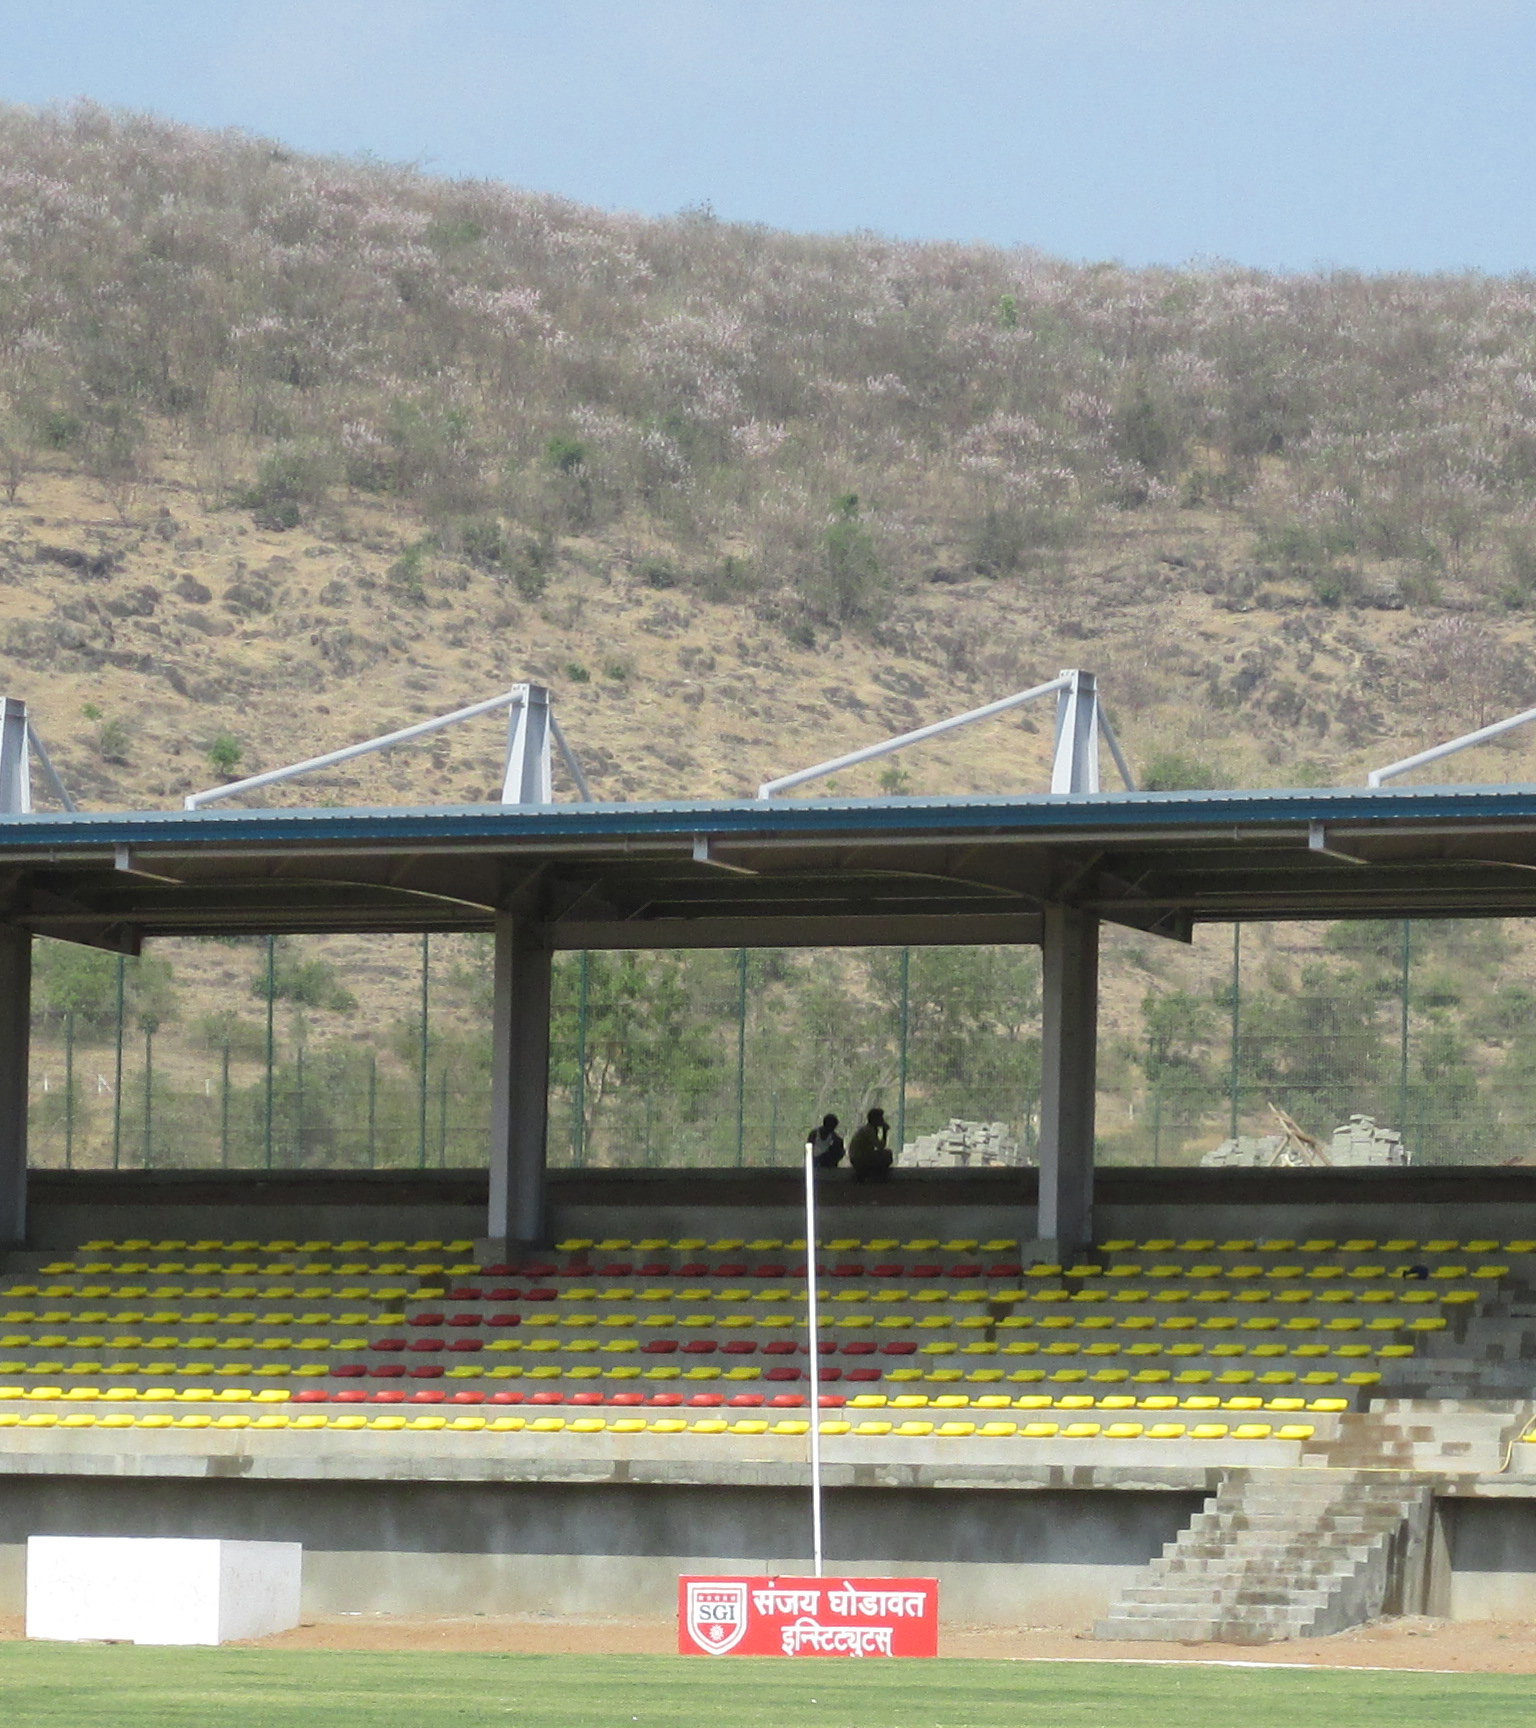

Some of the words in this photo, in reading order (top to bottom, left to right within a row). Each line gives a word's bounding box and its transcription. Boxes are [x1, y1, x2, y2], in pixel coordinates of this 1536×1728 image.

[698, 1604, 736, 1621] SGI
[751, 1580, 822, 1616] संजय
[827, 1580, 928, 1618] घोडावत
